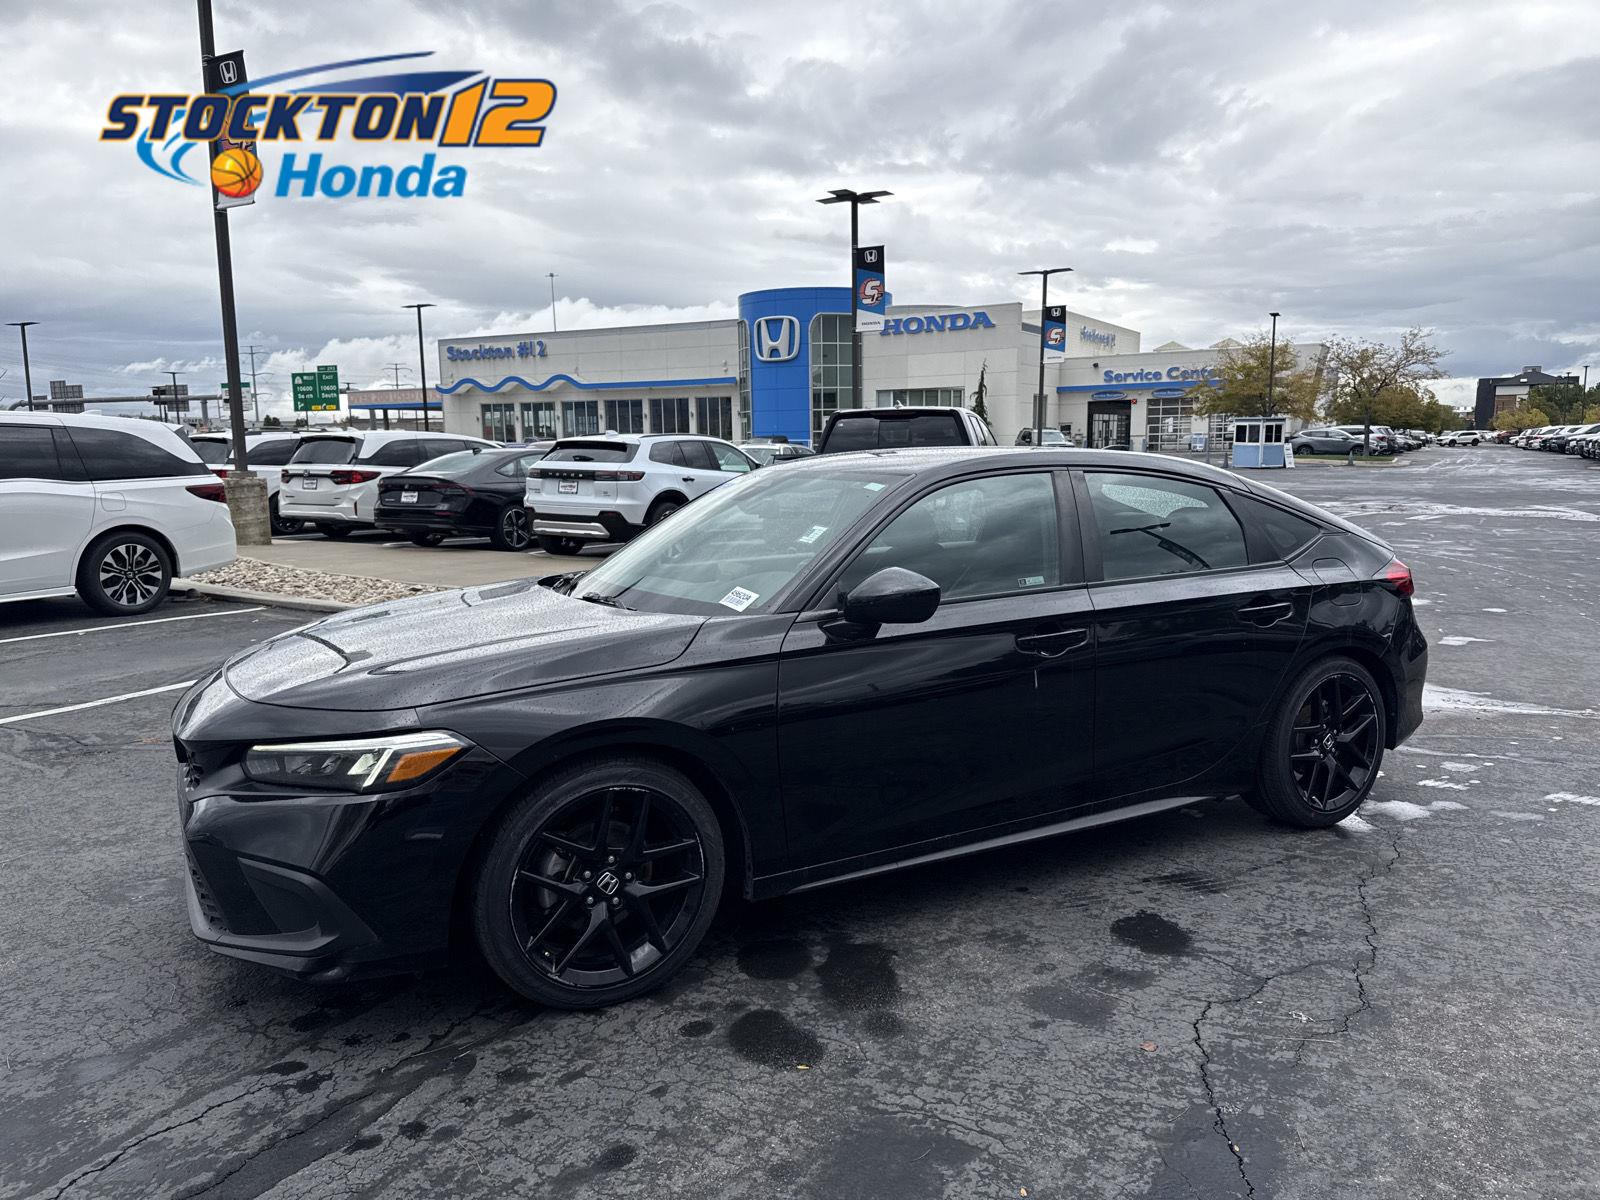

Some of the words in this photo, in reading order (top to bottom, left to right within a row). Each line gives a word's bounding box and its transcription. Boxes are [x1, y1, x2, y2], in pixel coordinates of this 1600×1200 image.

[880, 312, 995, 336] HONDA
[447, 345, 514, 361] Stockton
[517, 340, 548, 358] #12
[1103, 368, 1163, 384] Service
[1166, 366, 1216, 381] Cente
